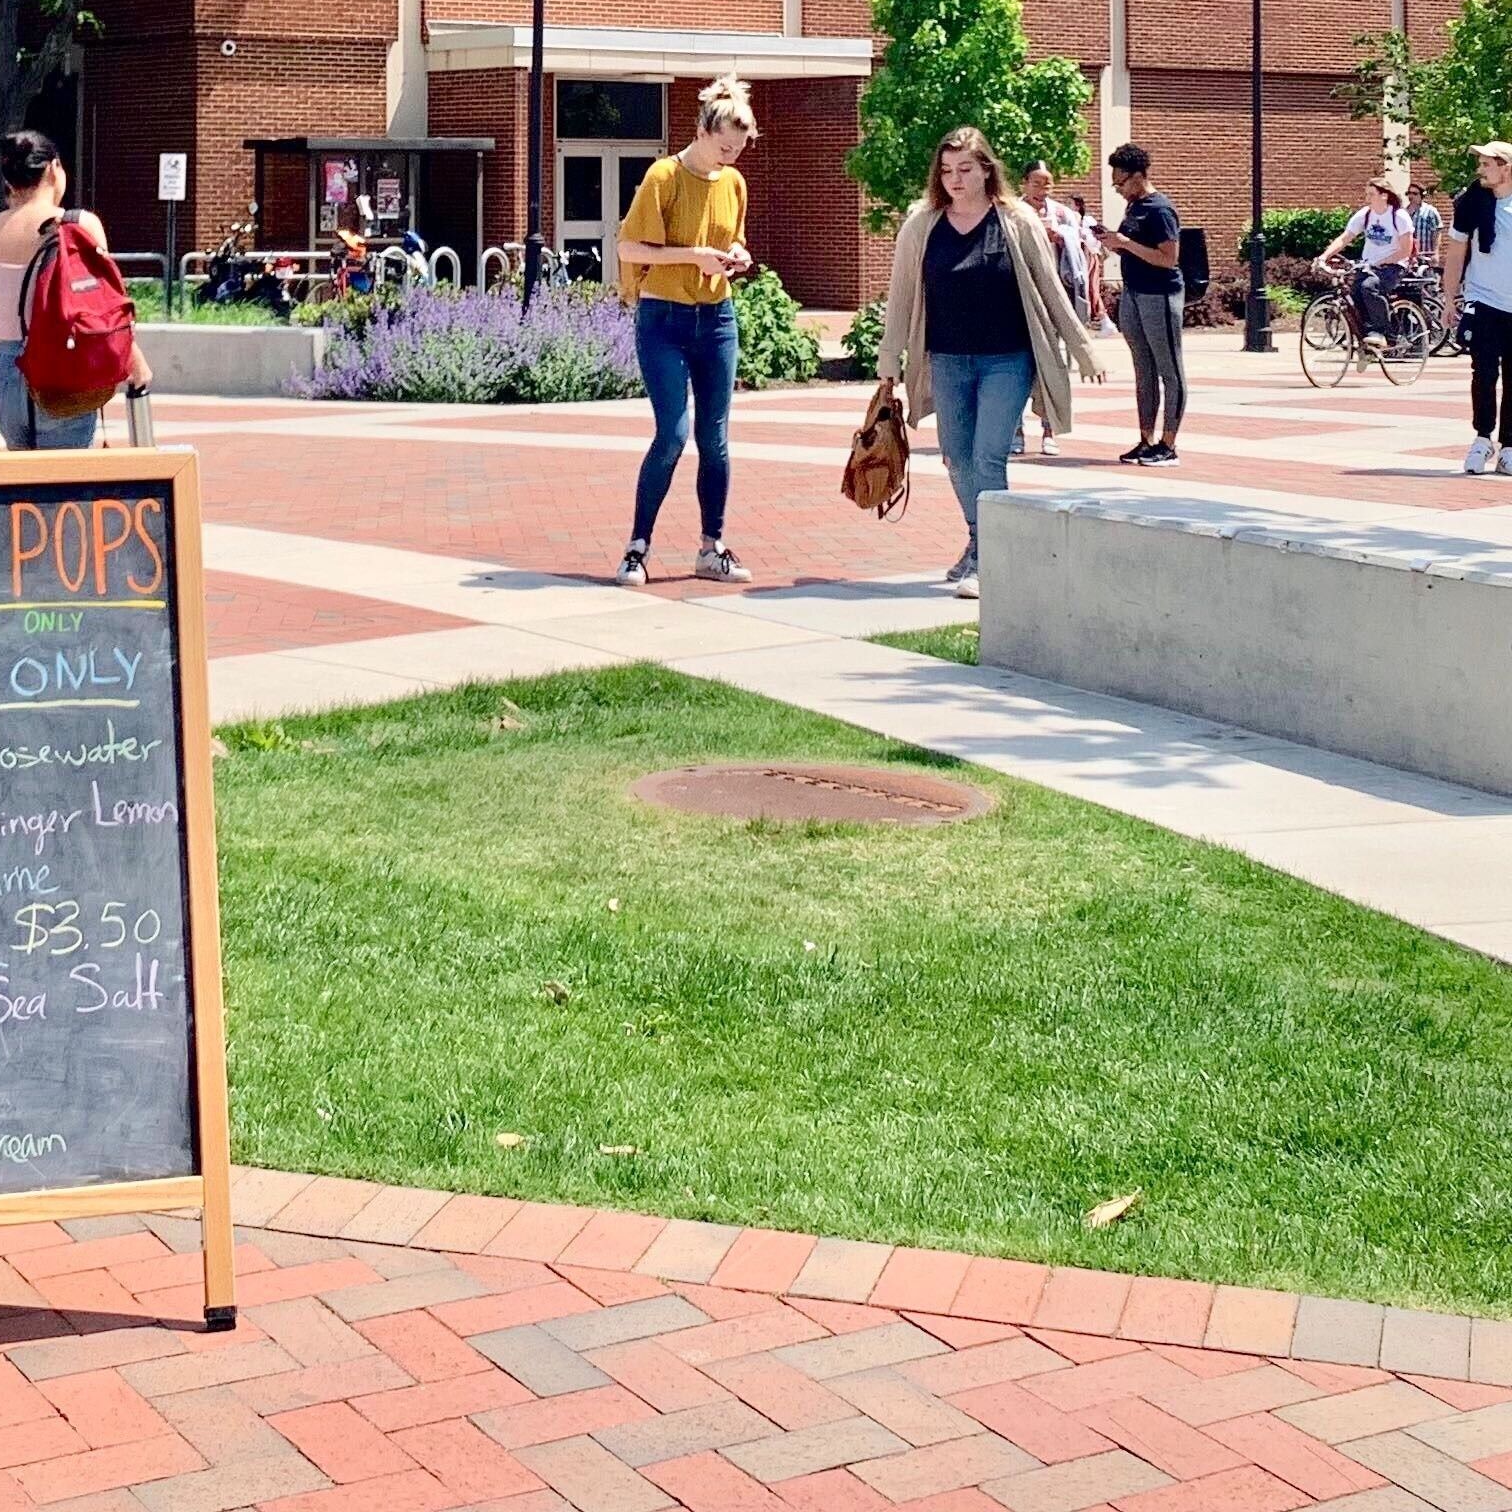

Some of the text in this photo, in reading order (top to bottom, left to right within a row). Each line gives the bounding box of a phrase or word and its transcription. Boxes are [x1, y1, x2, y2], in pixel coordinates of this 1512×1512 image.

[12, 498, 162, 597] POPS
[24, 610, 84, 633] ONLY
[11, 647, 143, 697] ONLY
[92, 780, 179, 825] Lemon
[69, 952, 164, 1013] Salt
